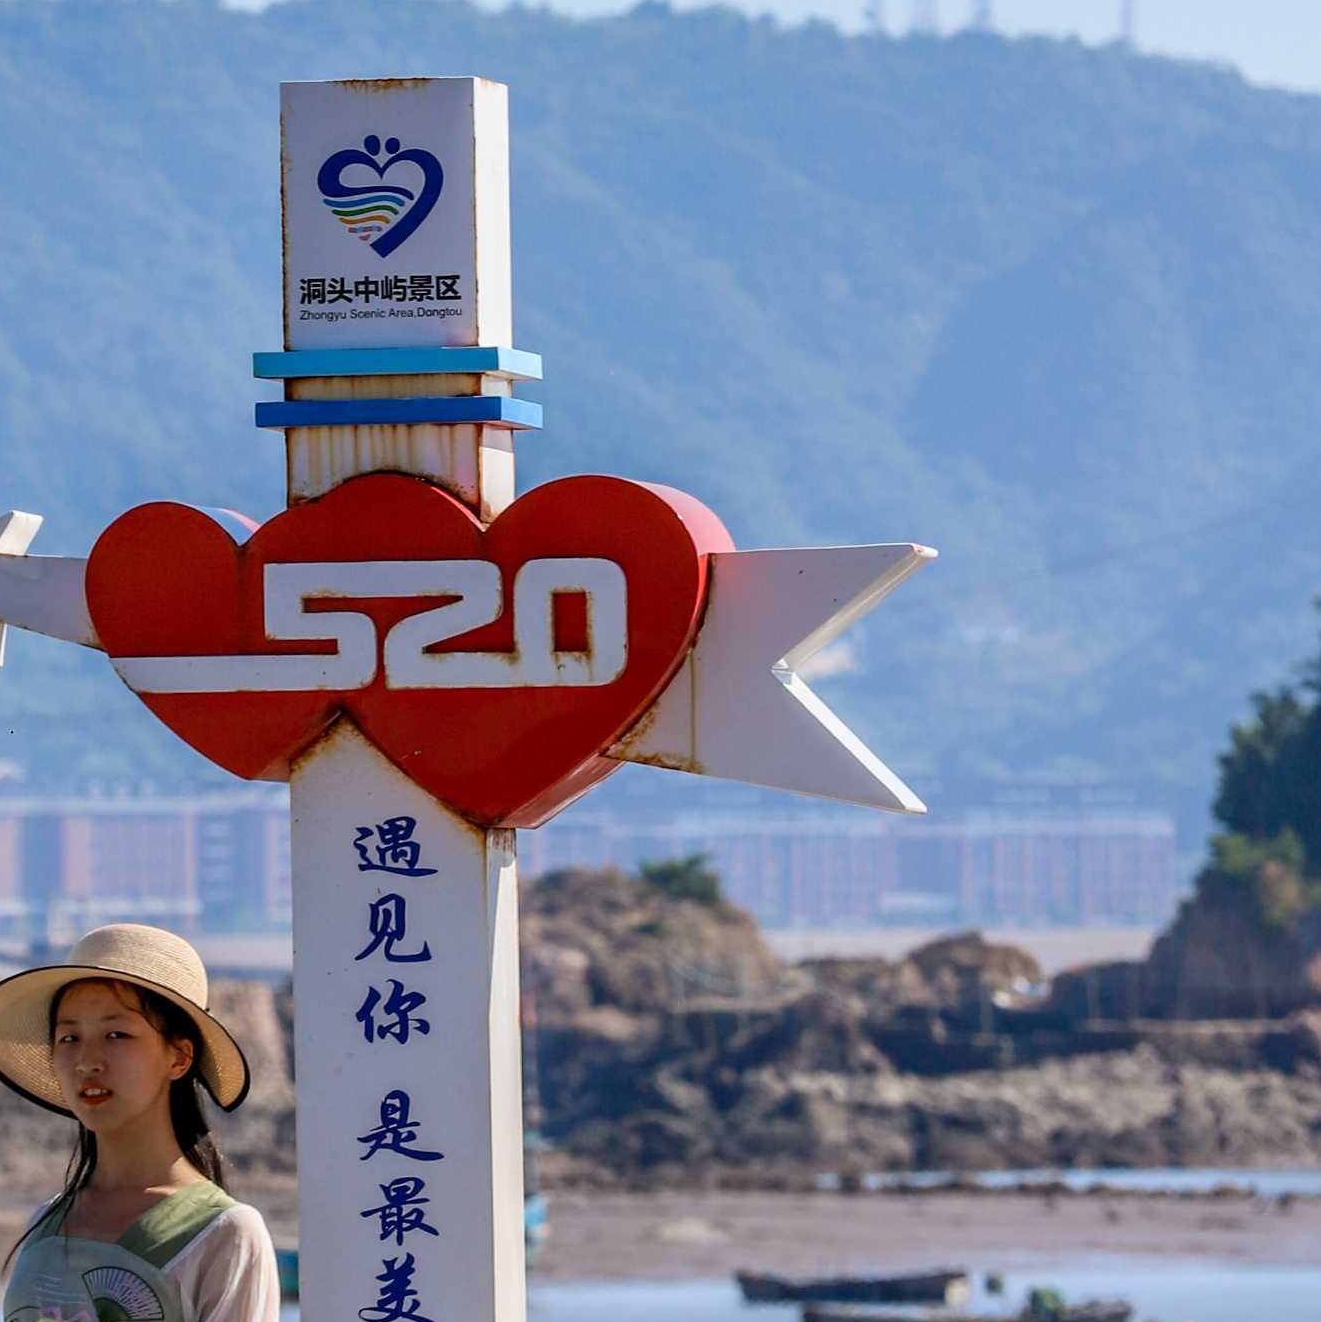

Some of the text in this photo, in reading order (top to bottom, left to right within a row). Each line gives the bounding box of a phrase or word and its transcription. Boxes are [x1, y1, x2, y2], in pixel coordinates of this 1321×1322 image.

[299, 274, 462, 305] 洞头中屿景区
[299, 309, 347, 322] Zhongyu
[349, 308, 386, 319] Scenic
[108, 557, 628, 694] 520
